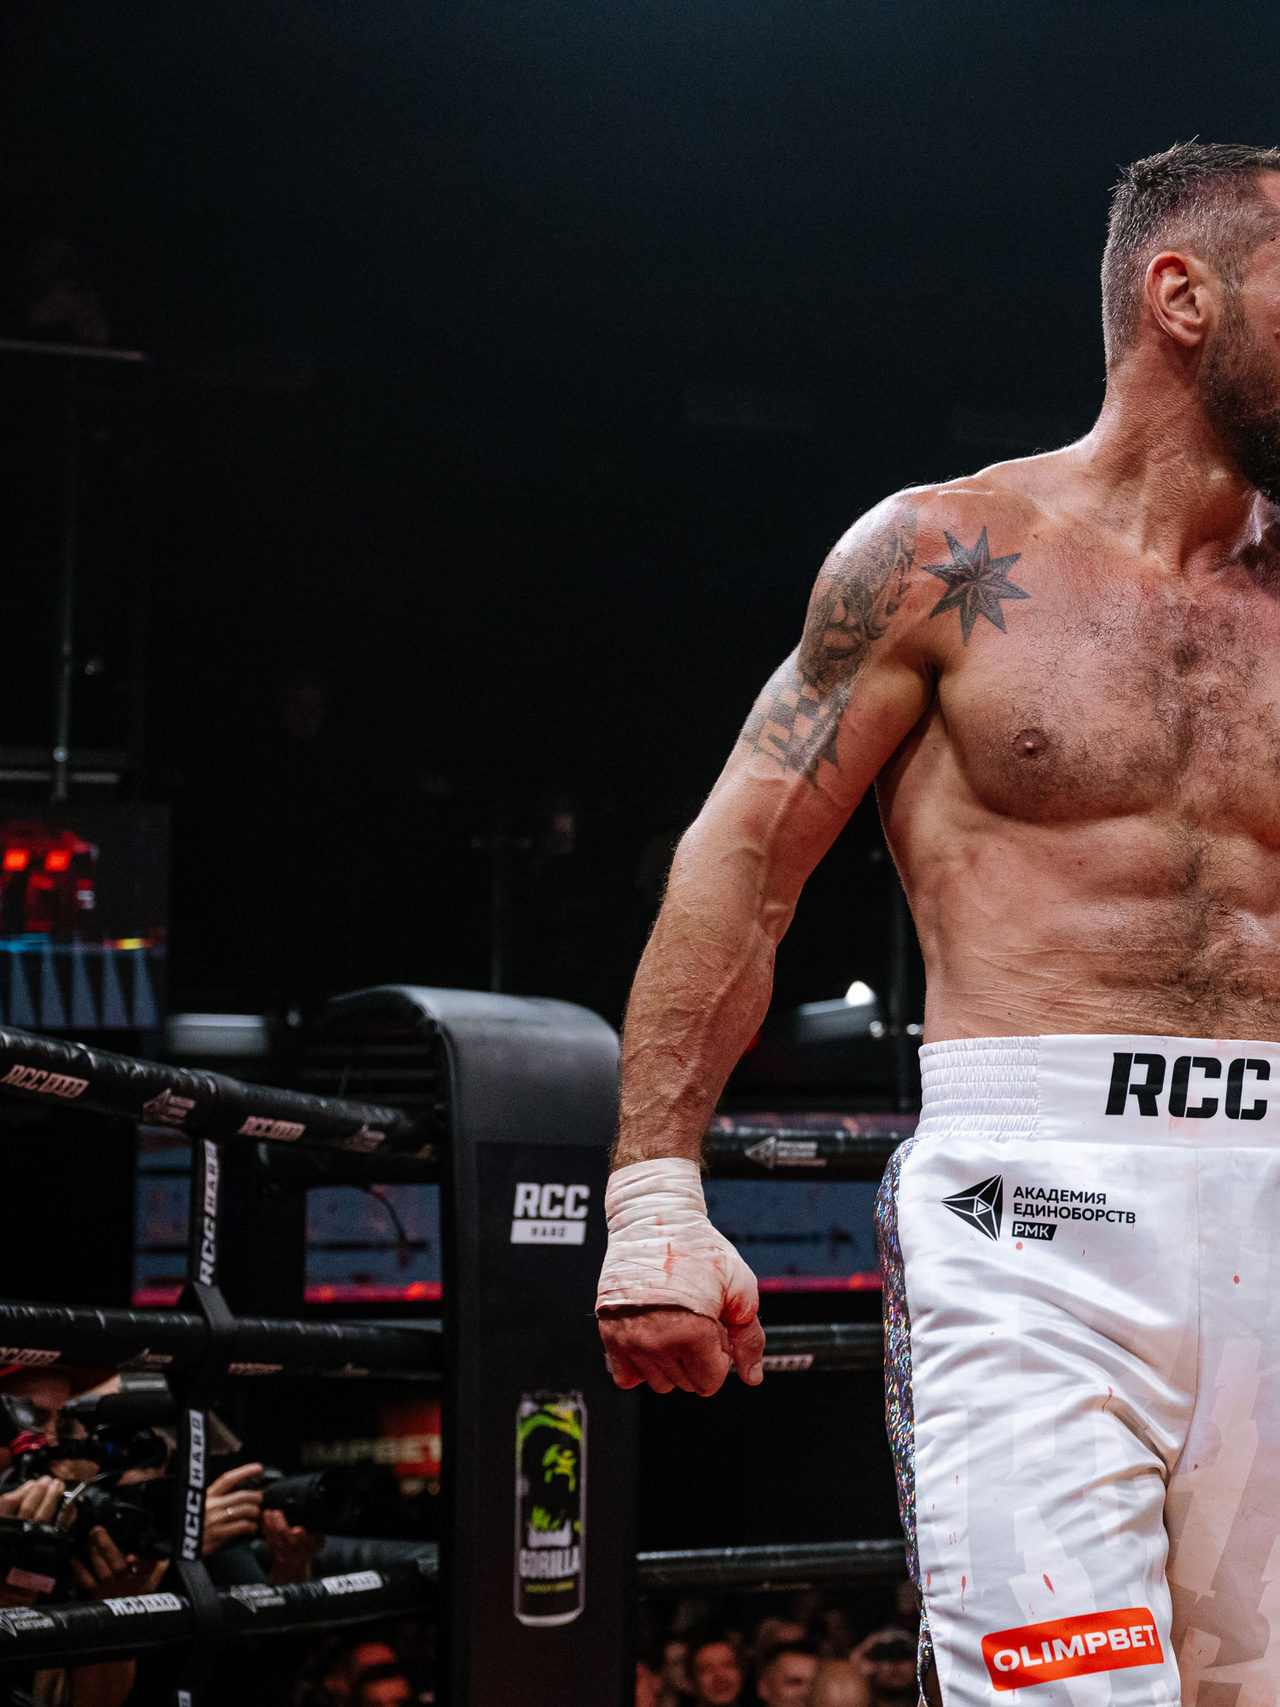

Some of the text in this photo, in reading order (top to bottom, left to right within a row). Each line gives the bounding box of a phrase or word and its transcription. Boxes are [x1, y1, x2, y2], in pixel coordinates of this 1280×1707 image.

[1105, 1052, 1271, 1121] RCC
[513, 1182, 591, 1219] RCC
[1013, 1186, 1107, 1205] АКАДЕМИЯ
[1013, 1203, 1136, 1224] ЕДИНОБОРСТВ
[199, 1216, 217, 1286] RCC
[1014, 1223, 1050, 1238] РМК
[182, 1414, 204, 1560] RCC HARD
[993, 1625, 1155, 1672] OLIMPBET
